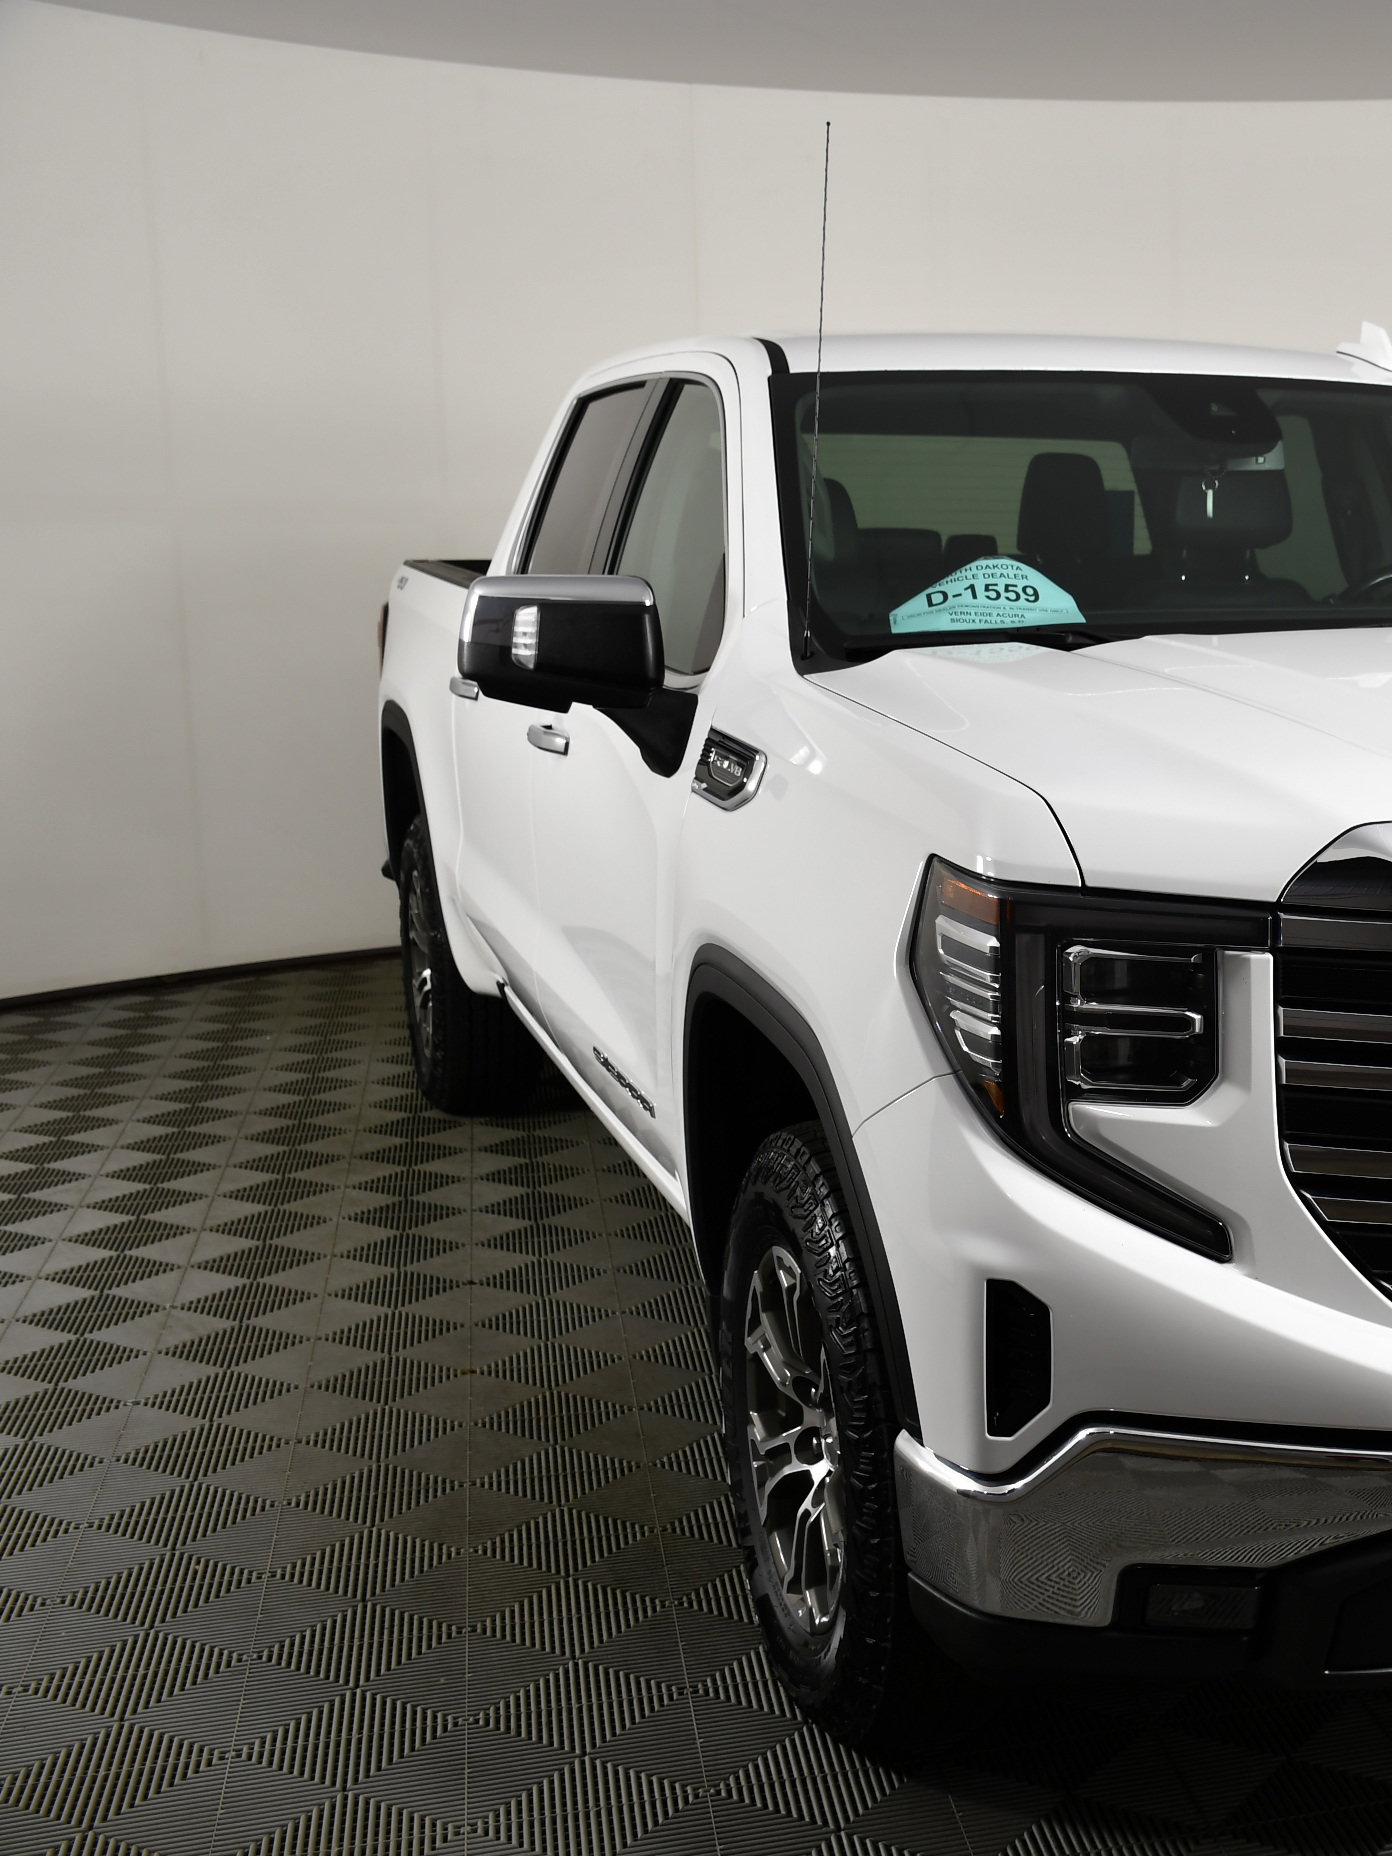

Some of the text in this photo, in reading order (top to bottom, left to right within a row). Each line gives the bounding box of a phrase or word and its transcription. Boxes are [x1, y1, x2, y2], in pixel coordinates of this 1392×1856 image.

[946, 563, 1023, 577] UTH DAKOTA
[982, 572, 1029, 581] DEALER
[925, 583, 1040, 608] D-1559
